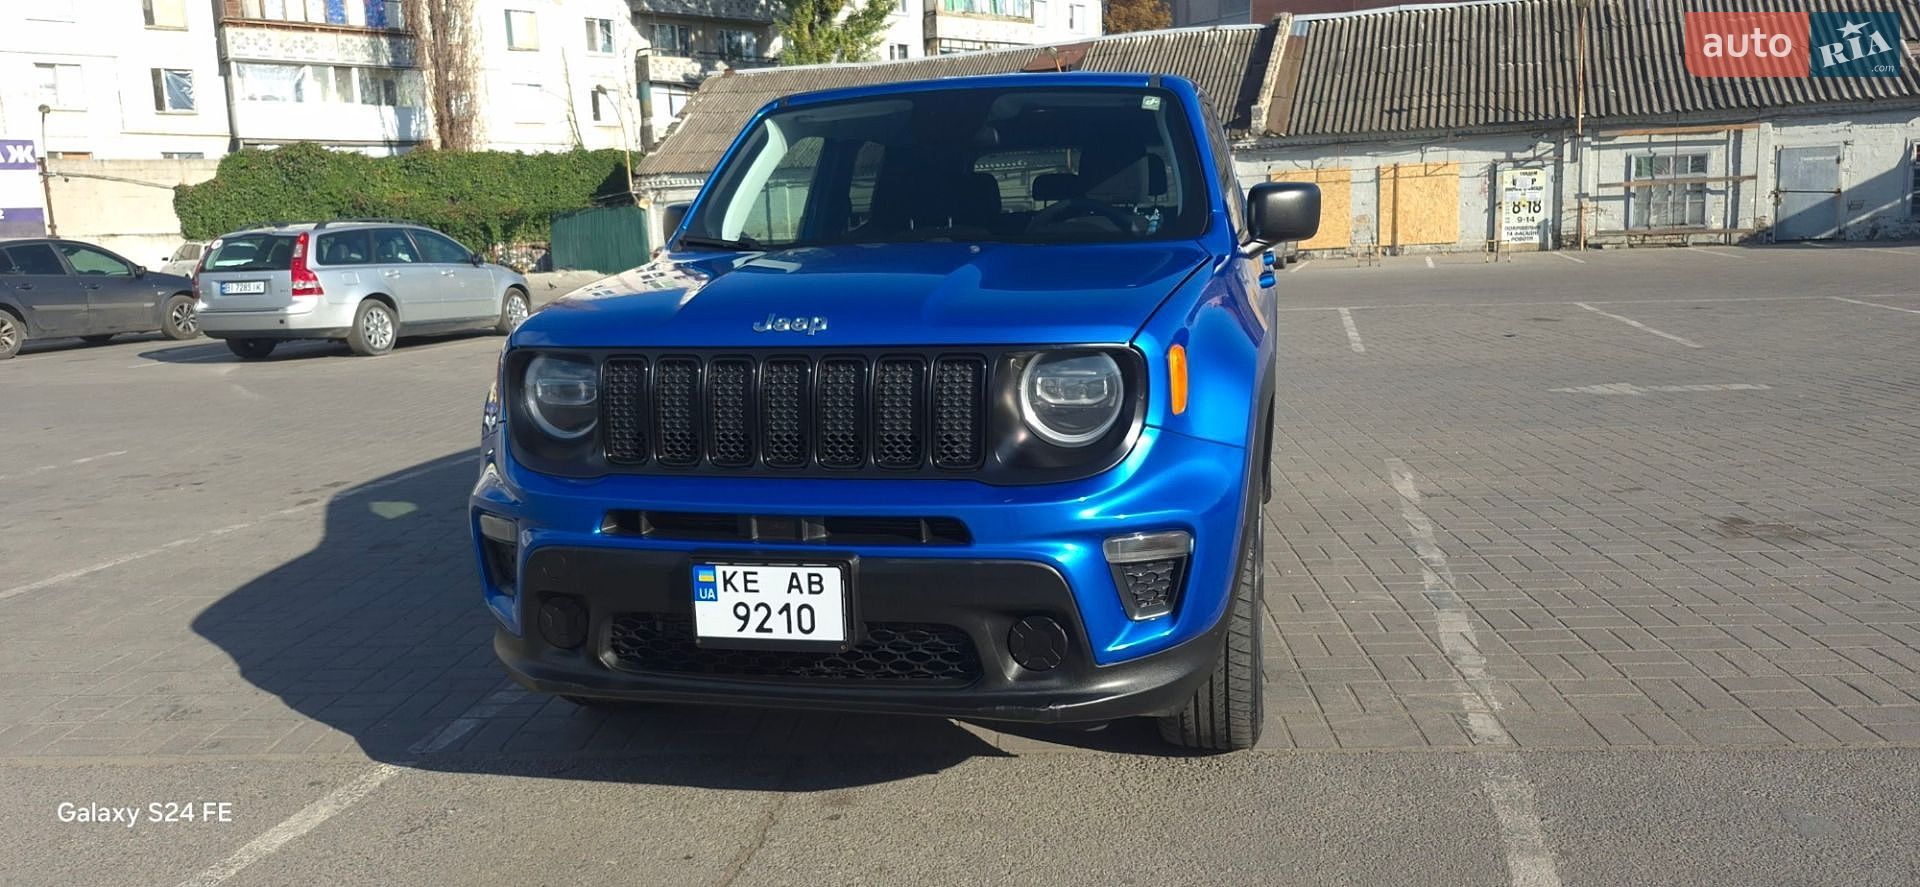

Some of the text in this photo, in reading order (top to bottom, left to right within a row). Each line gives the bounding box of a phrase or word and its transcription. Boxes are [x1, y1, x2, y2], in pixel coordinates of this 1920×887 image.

[753, 313, 828, 336] Jeep
[699, 588, 716, 600] UA
[722, 570, 825, 595] KE AB
[733, 601, 816, 635] 9210
